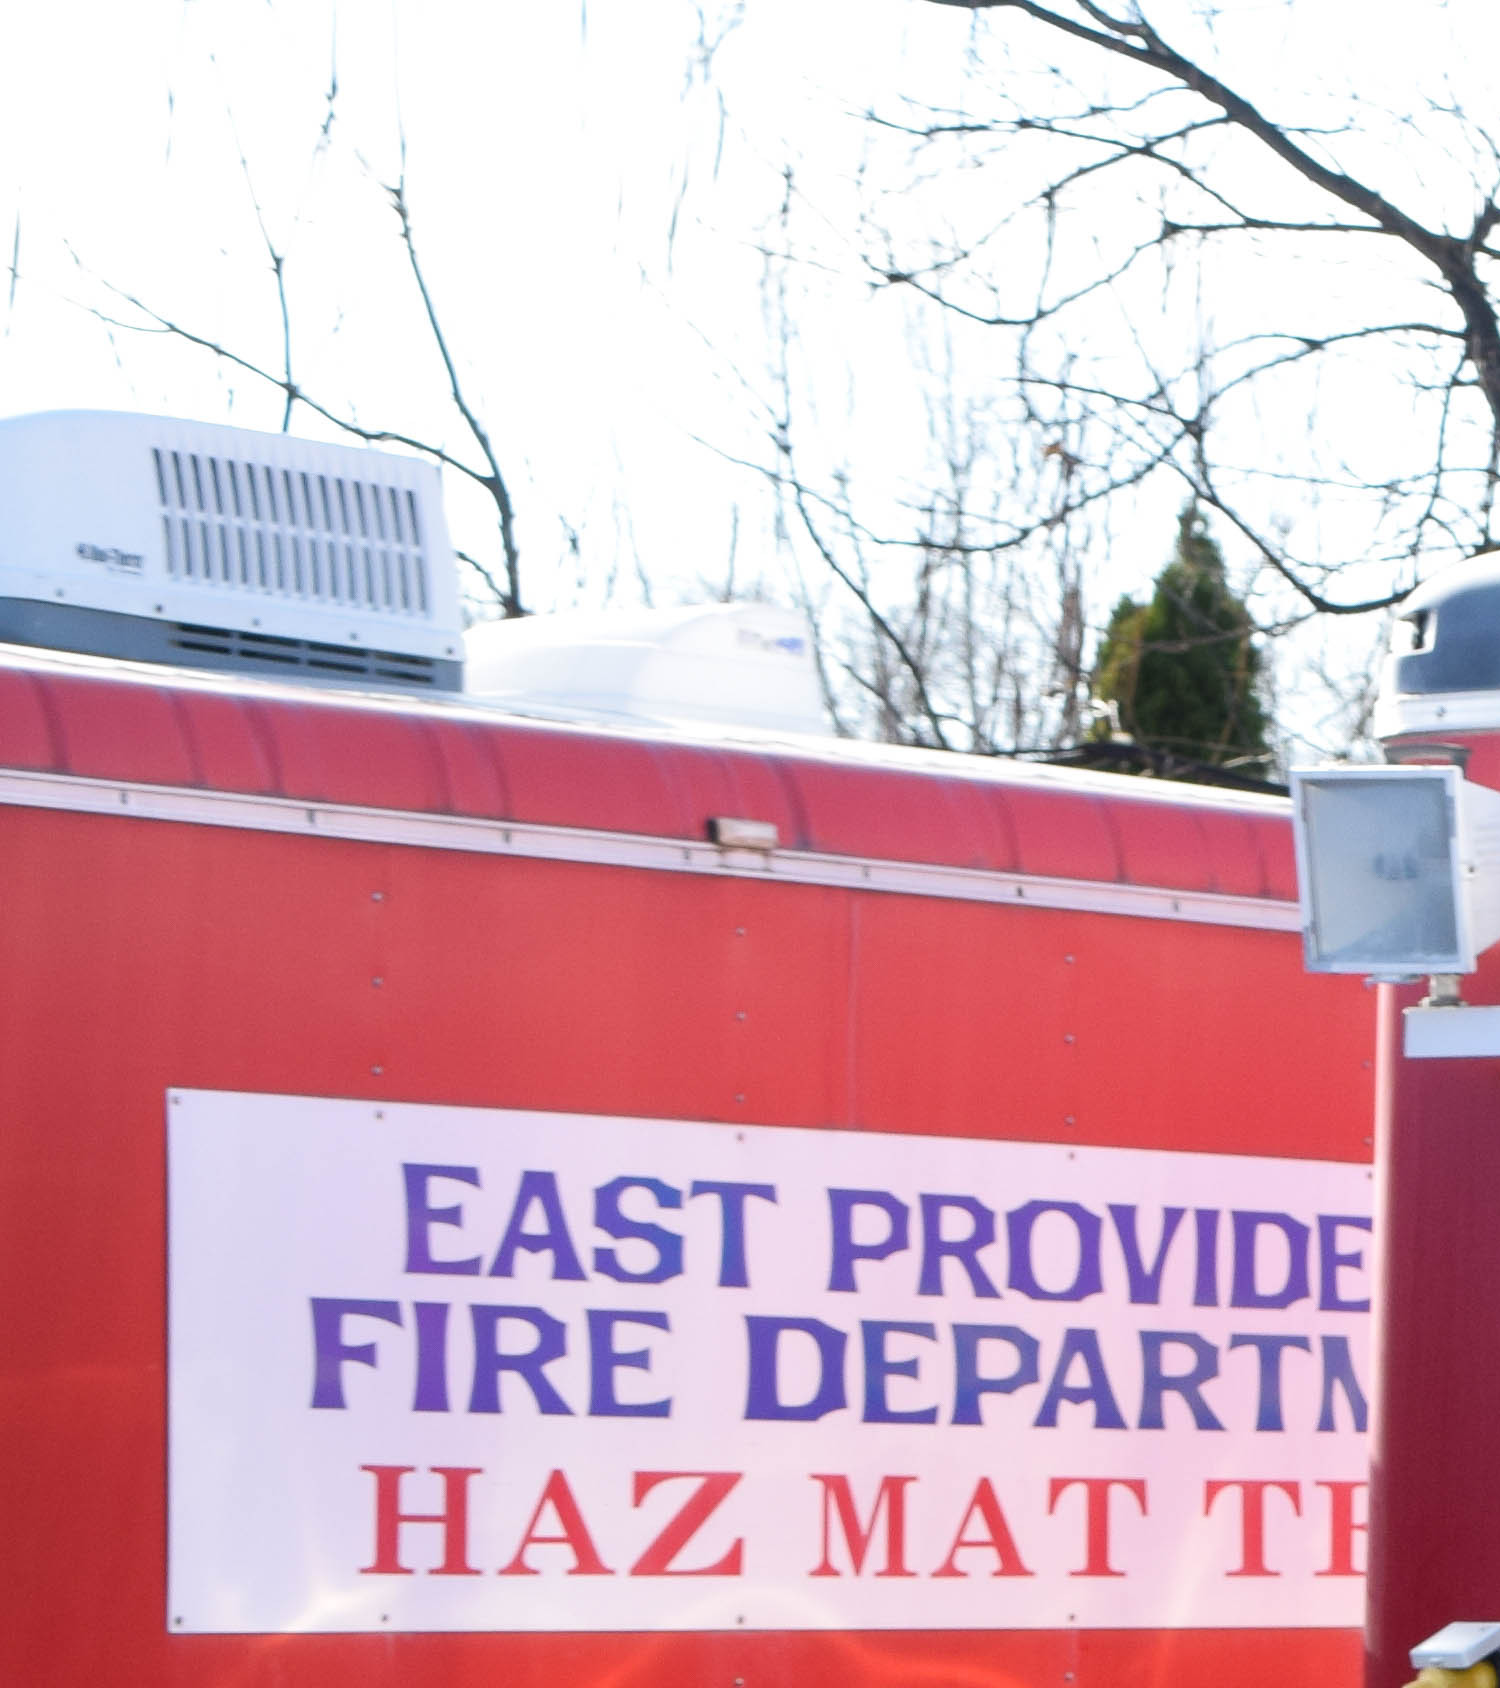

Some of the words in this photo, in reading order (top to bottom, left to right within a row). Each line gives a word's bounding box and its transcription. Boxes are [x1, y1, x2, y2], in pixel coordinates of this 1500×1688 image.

[402, 1162, 779, 1288] EAST
[310, 1297, 673, 1418] FIRE
[357, 1464, 743, 1577] HAZ
[808, 1474, 1148, 1577] MAT
